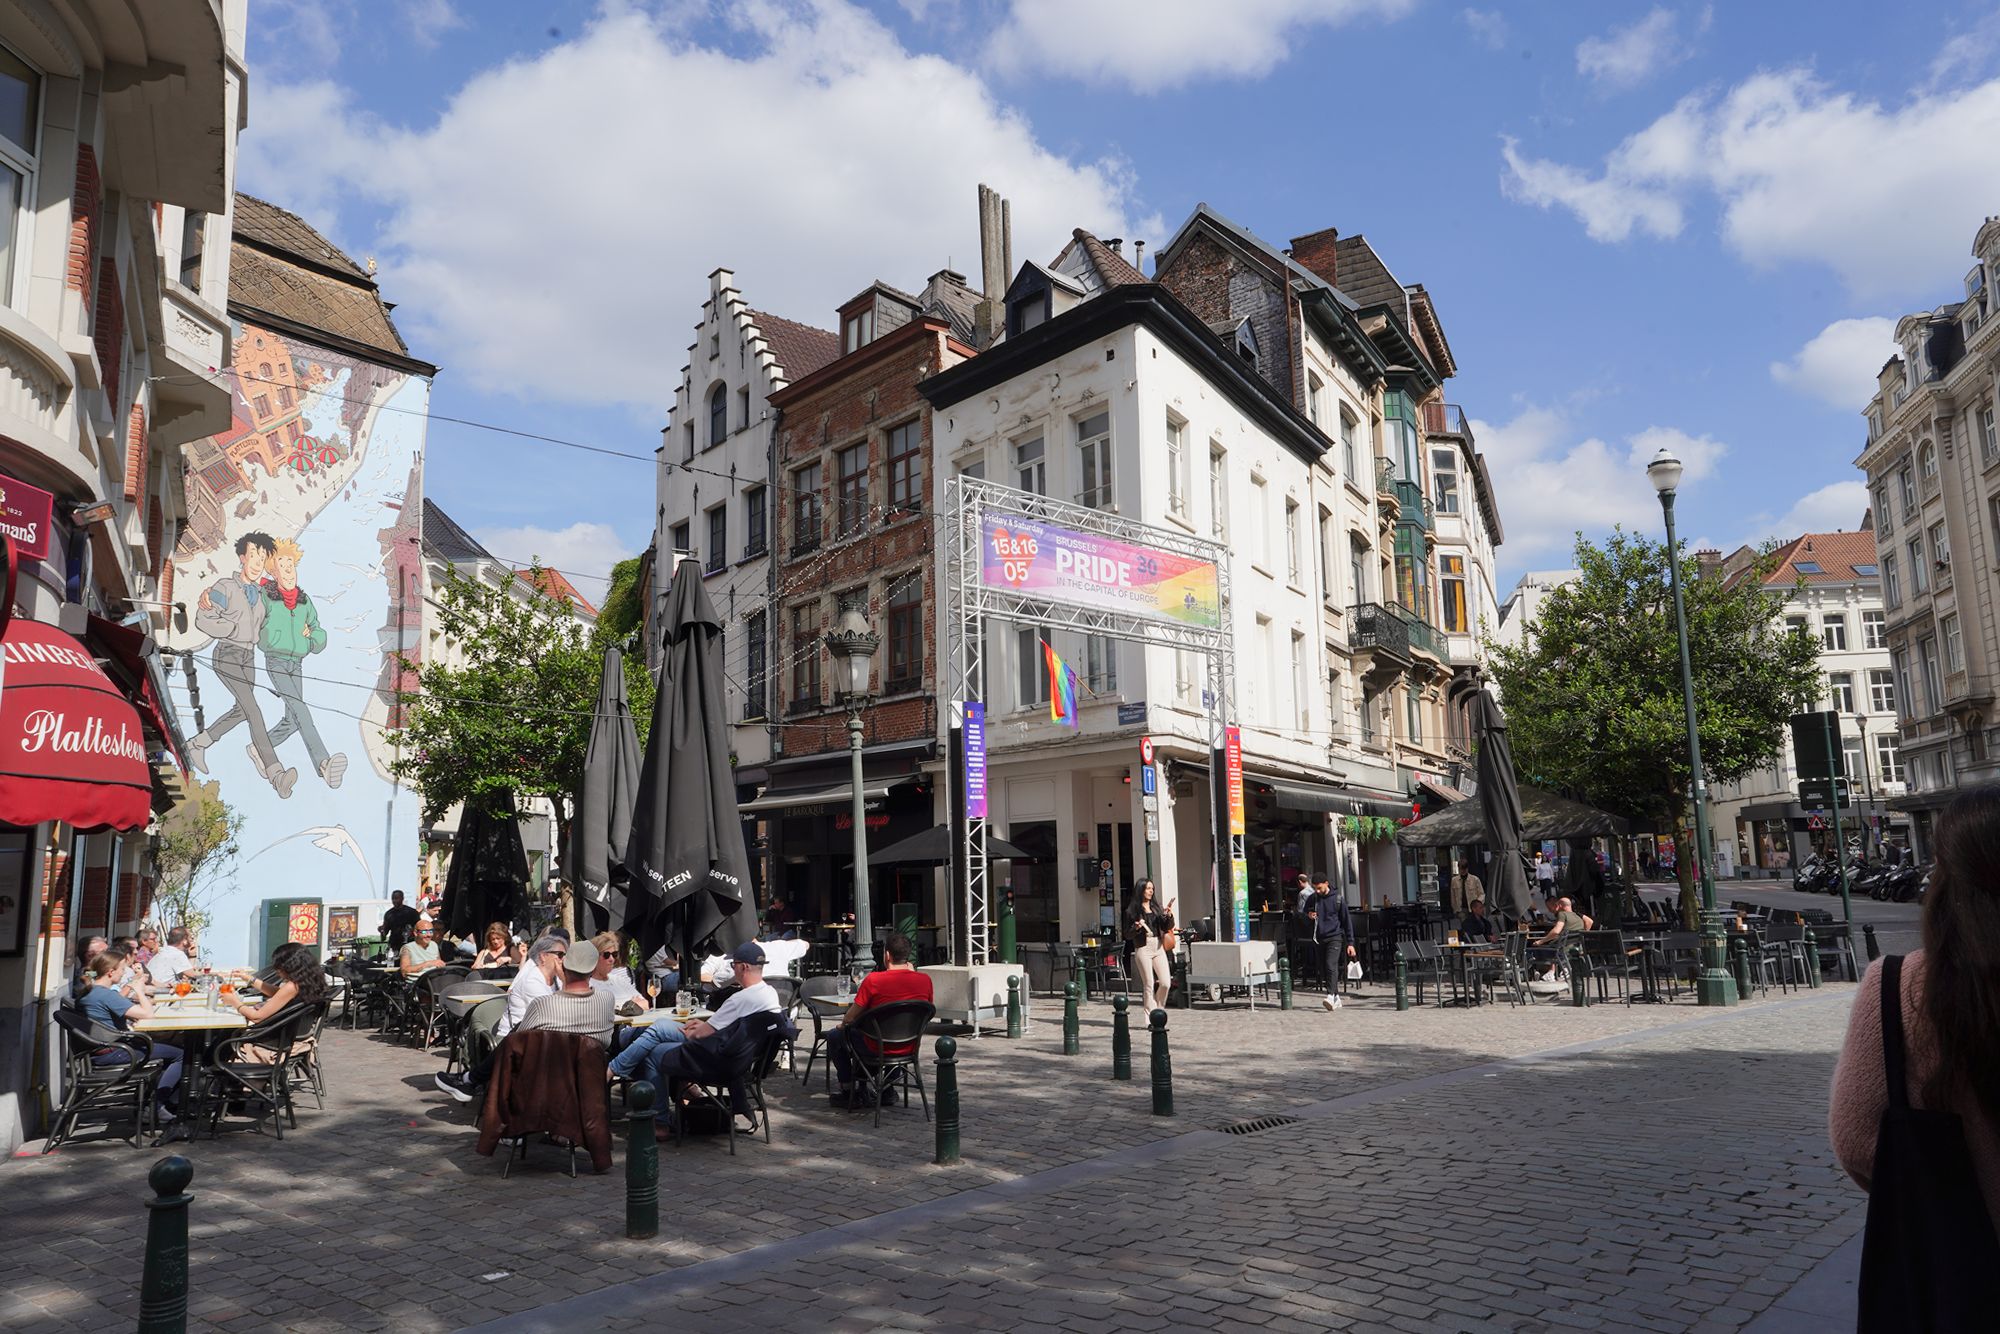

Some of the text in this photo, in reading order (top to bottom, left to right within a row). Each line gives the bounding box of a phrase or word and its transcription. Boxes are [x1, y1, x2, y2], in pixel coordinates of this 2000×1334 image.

[7, 507, 23, 516] 1822
[984, 513, 1044, 535] Friday & Saturday
[991, 537, 1039, 555] 15&16
[1056, 536, 1097, 553] BRUSSELS
[1003, 561, 1029, 582] 05
[1055, 547, 1132, 587] PRIDE
[1136, 555, 1158, 577] 30
[1056, 577, 1159, 606] IN THE CAPITAL OF EUROPE
[21, 709, 146, 764] Plattesteen
[584, 881, 599, 893] rve
[709, 868, 739, 886] serve
